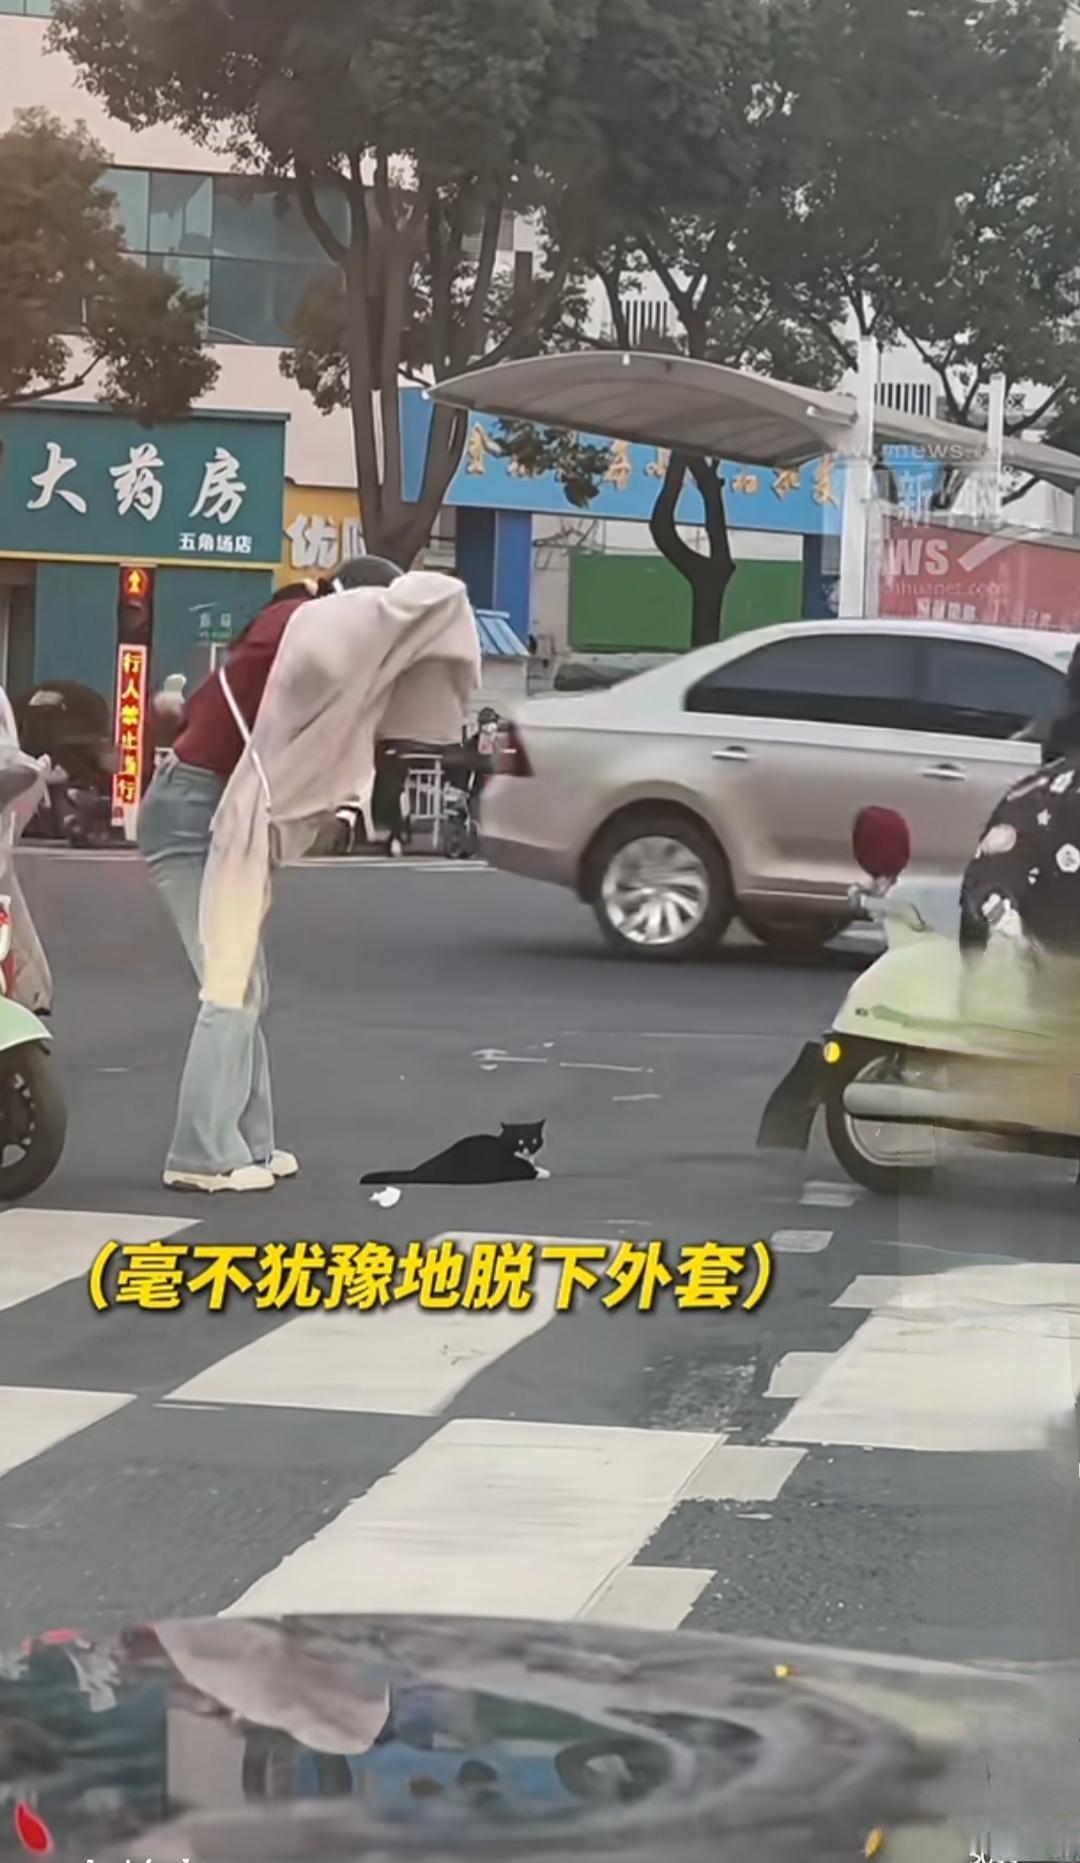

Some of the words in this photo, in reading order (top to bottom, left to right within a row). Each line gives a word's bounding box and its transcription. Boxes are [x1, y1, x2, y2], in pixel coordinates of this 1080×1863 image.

[26, 441, 247, 525] 大药房
[178, 532, 253, 554] 五角场店
